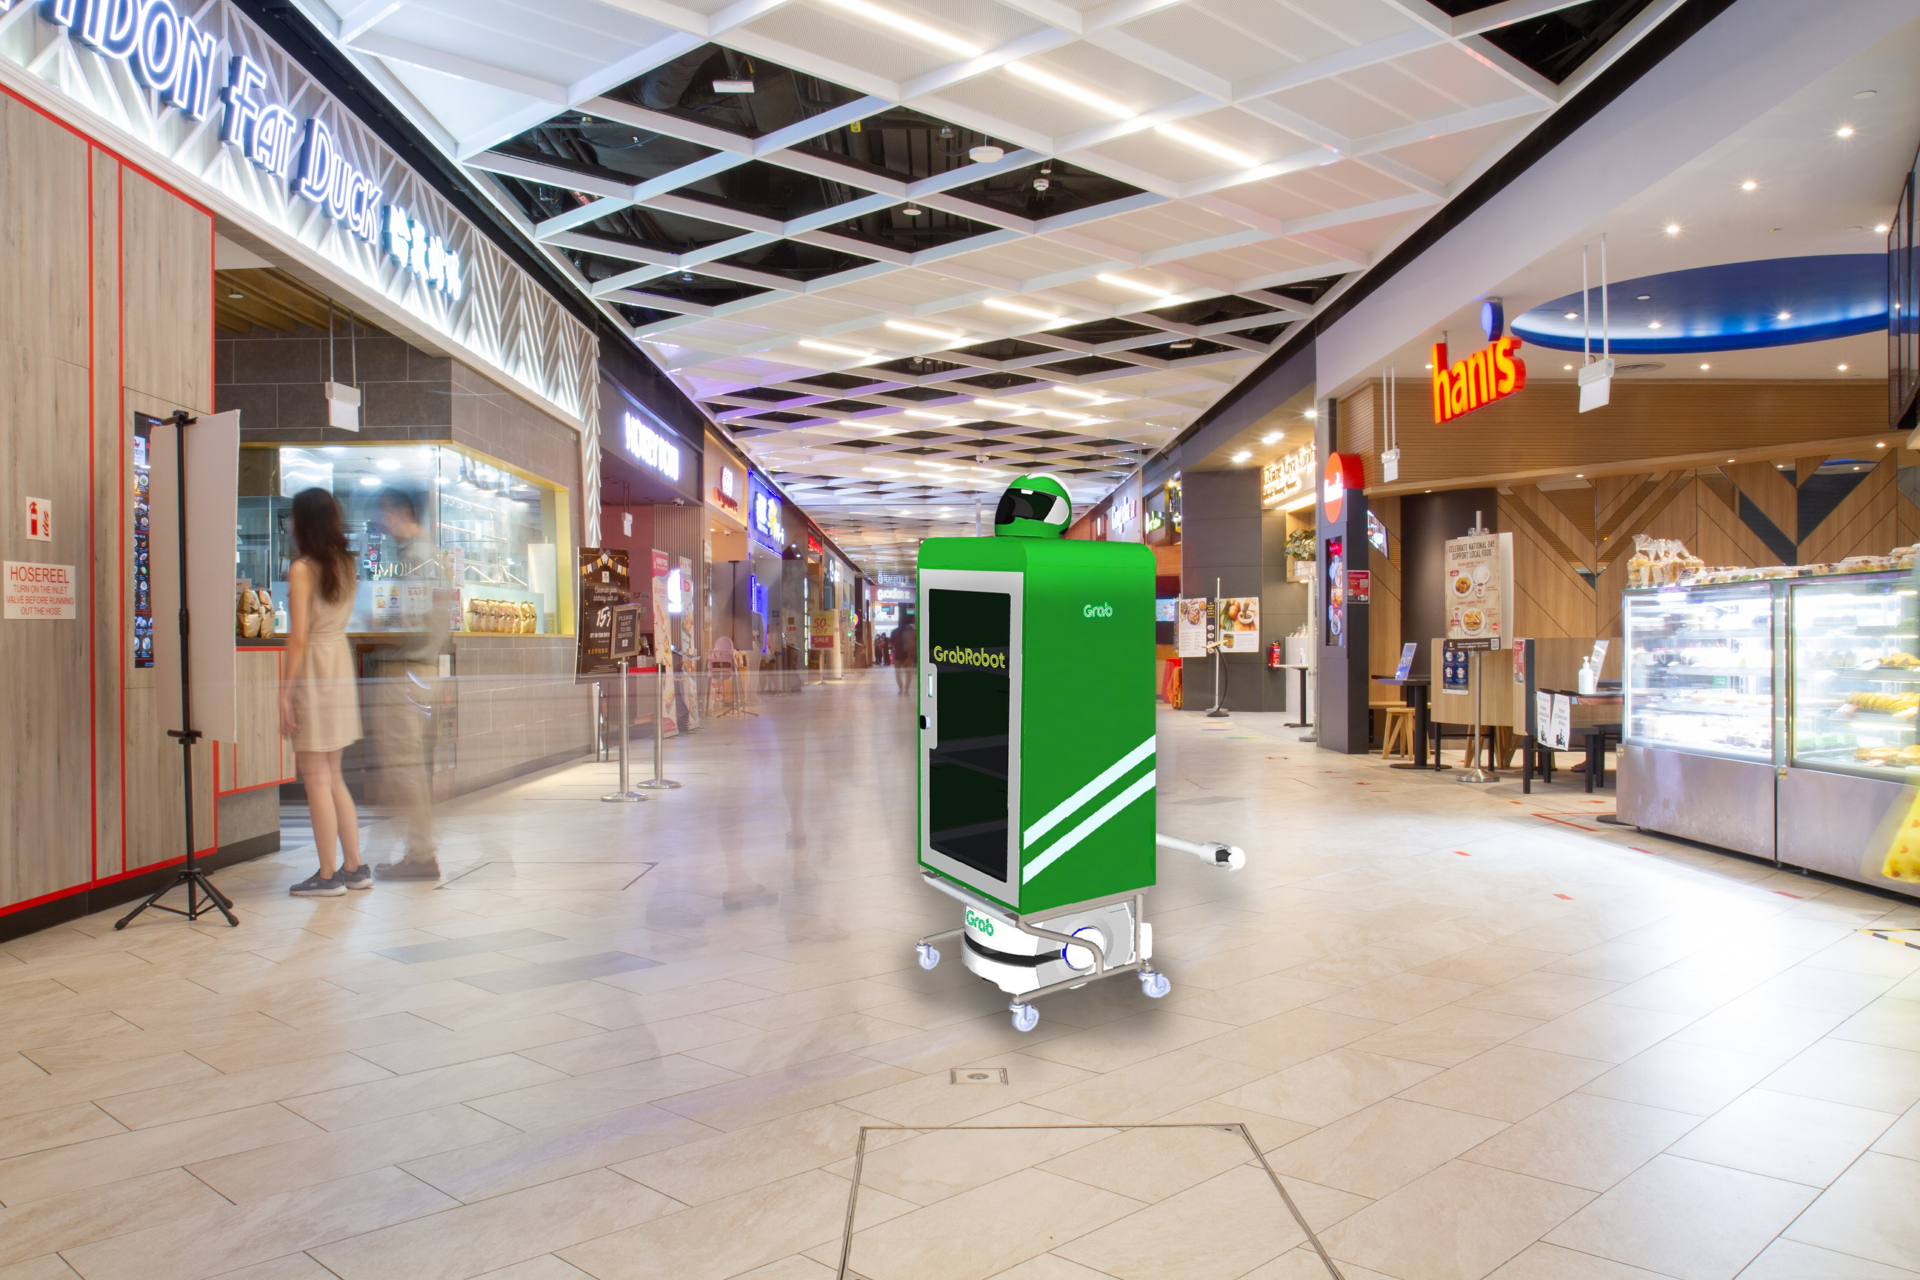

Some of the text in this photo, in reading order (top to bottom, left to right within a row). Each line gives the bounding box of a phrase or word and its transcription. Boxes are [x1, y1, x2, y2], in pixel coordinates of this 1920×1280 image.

[1448, 540, 1495, 553] CELEBRATE NATIONAL DAY
[1451, 548, 1492, 561] SUPPORT LOCAL FOOD
[10, 565, 70, 584] HOSEREEL
[13, 584, 68, 595] TURN ON THE INLET
[6, 595, 75, 606] VALVE BEFORE RUNNING
[20, 606, 62, 616] OUT THE HOSE
[1083, 602, 1113, 618] Grab
[933, 645, 1006, 669] GrabRobot
[966, 909, 994, 937] Grab
